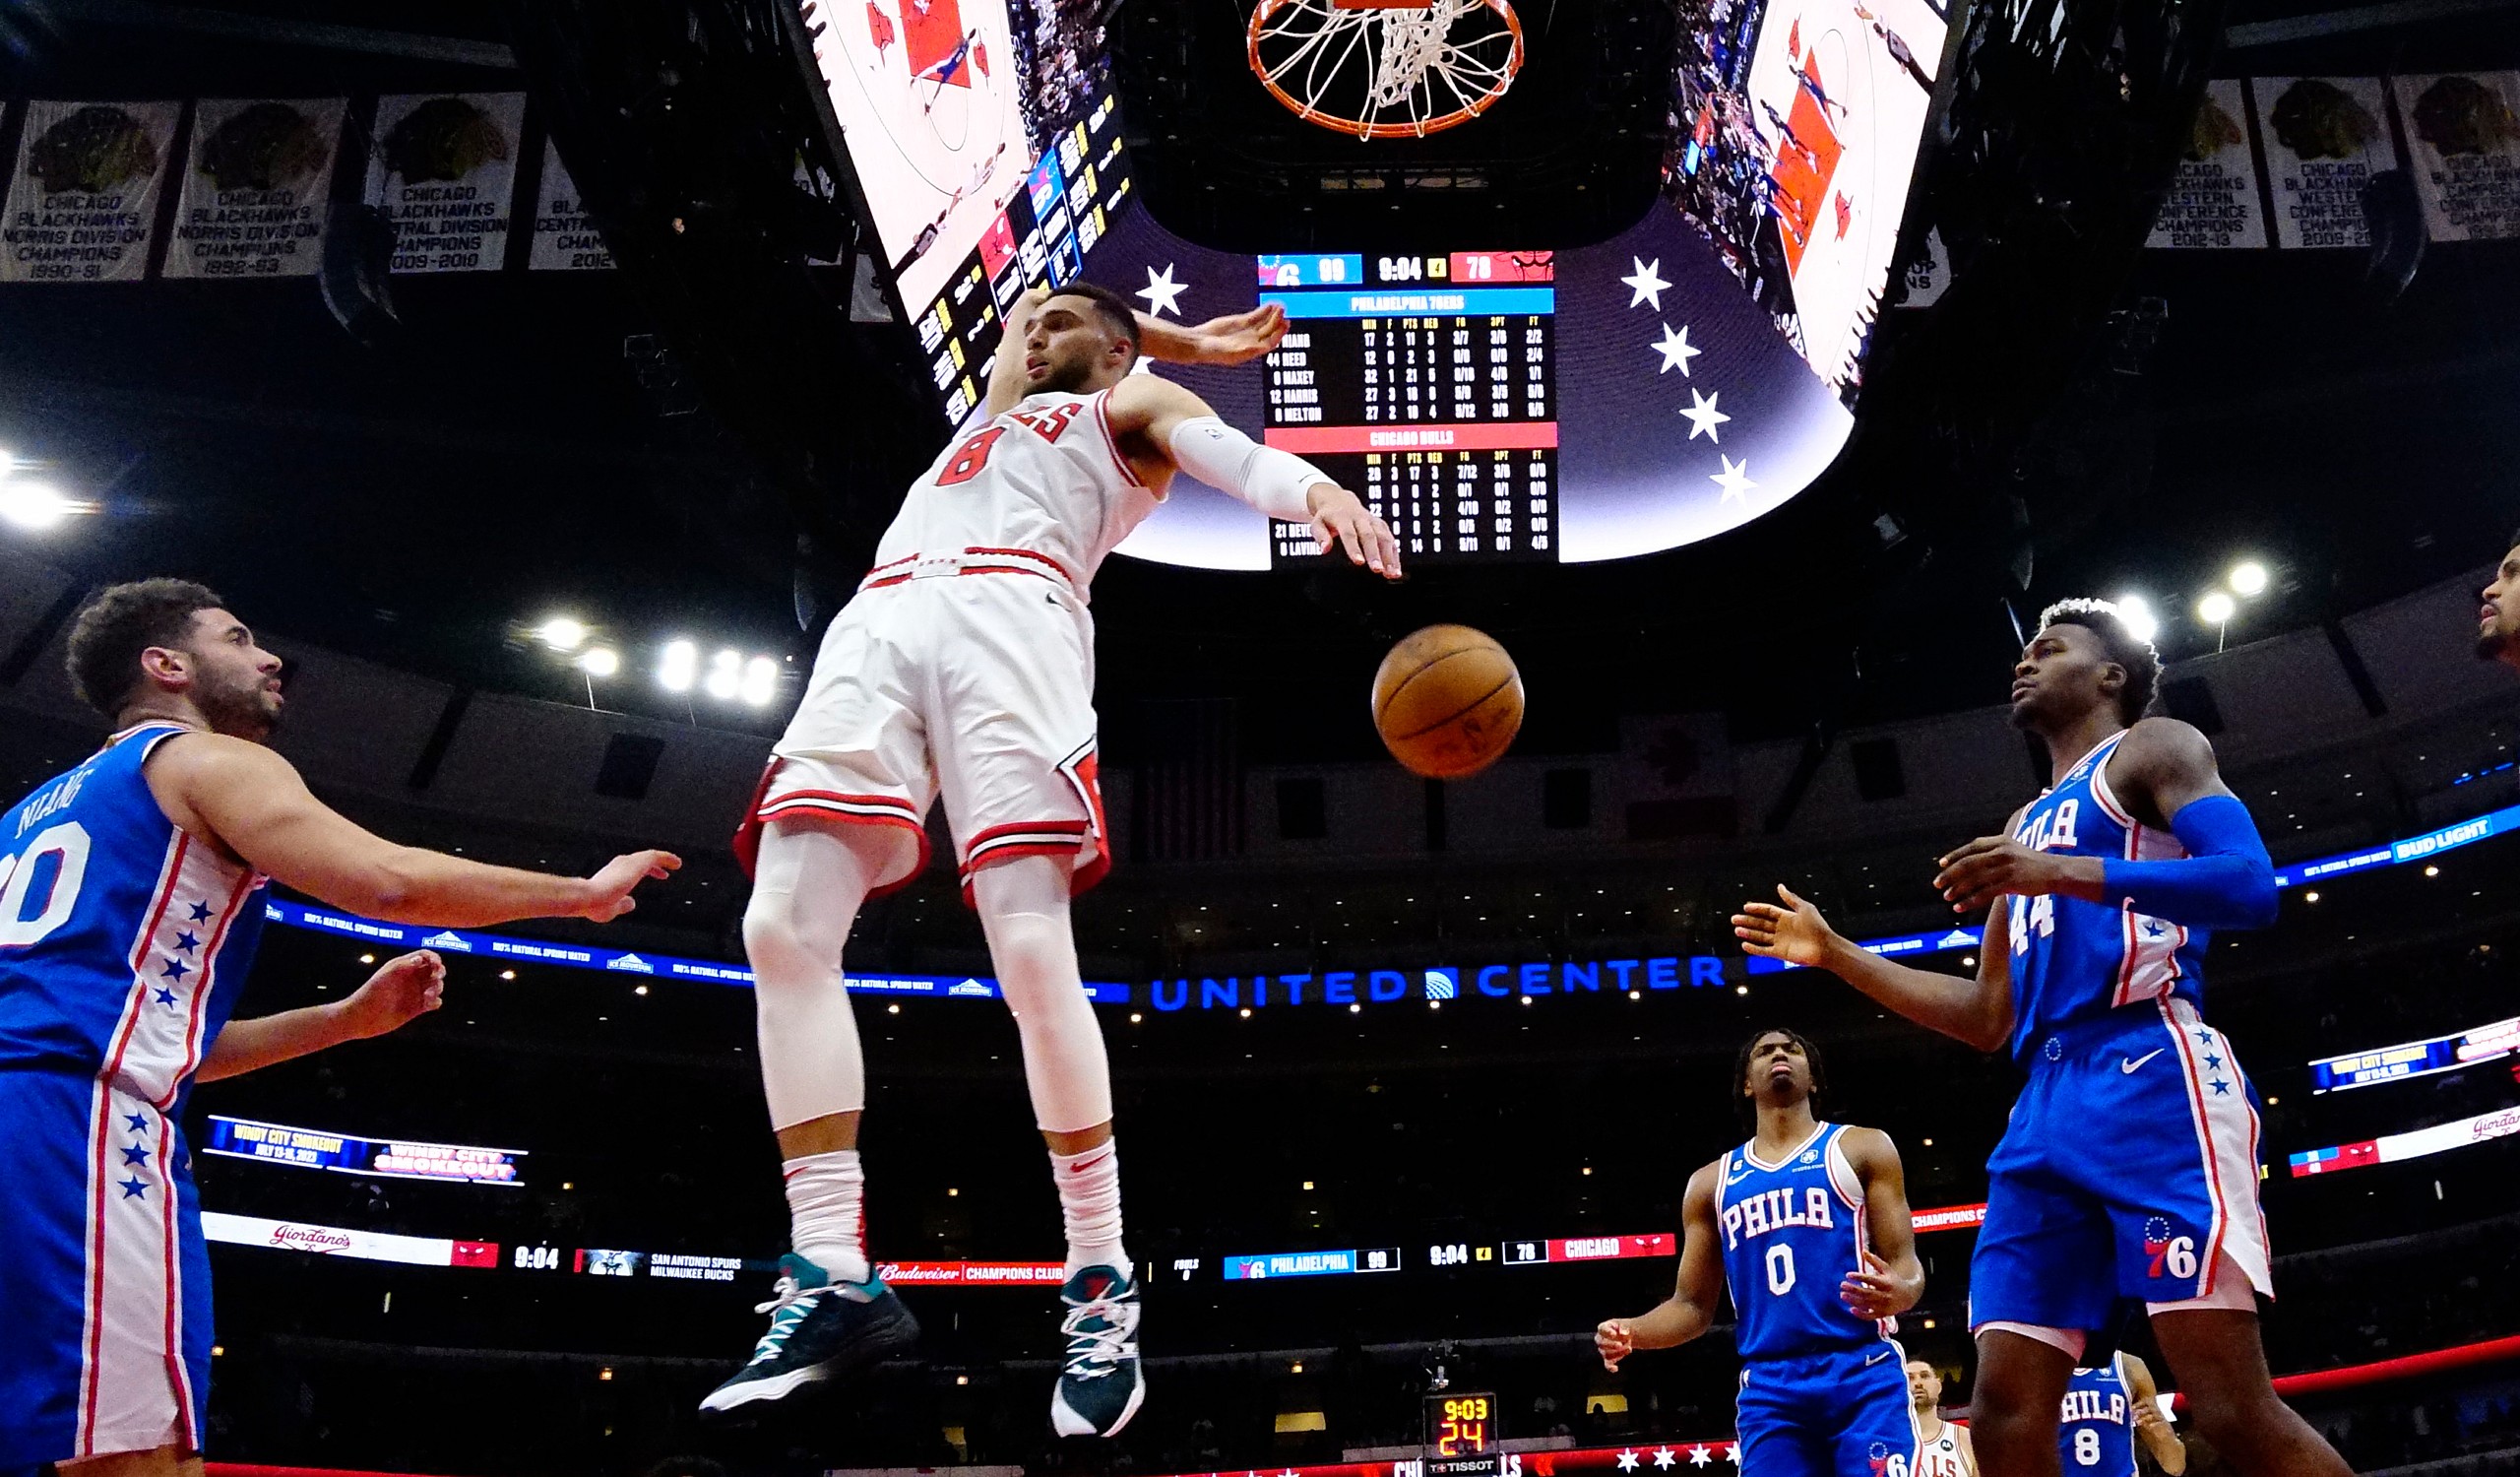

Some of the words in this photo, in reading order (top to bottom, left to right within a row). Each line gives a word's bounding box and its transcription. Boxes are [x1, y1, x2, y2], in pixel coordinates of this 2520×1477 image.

[2300, 163, 2366, 176] CHICAGO
[218, 191, 293, 207] CHICAGO
[403, 186, 476, 202] CHICAGO
[44, 196, 122, 211] CHICAGO
[18, 212, 141, 226] BLACKHAWKS
[191, 207, 311, 223] BLACKHAWKS
[72, 227, 147, 244] DIVISION
[439, 219, 507, 235] DIVISION
[18, 246, 122, 263] CHAMPIONS
[391, 253, 478, 269] 009-2010
[572, 253, 611, 268] 2012
[1320, 258, 1345, 283] 99
[1379, 257, 1421, 282] 9:04
[1433, 262, 1441, 275] 4
[1467, 256, 1491, 280] 78
[1352, 296, 1428, 312] PHILADELPHIA
[1364, 333, 1375, 347] 17
[1387, 332, 1394, 347] 2
[1406, 332, 1415, 346] 11
[1527, 329, 1543, 344] 2/2
[1267, 353, 1281, 367] 44
[1364, 351, 1376, 365] 12
[1408, 351, 1415, 364] 2
[1527, 348, 1543, 362] 2/4
[1283, 370, 1314, 385] MAXEY
[1406, 368, 1417, 383] 21
[1270, 390, 1283, 404] 12
[1365, 388, 1378, 402] 27
[1284, 407, 1322, 421] MELTON
[1366, 406, 1378, 419] 27
[1389, 406, 1396, 419] 2
[1429, 405, 1436, 418] 4
[1370, 431, 1418, 447] CHICAGO
[934, 425, 1007, 487] 8
[1410, 466, 1419, 480] 17
[1457, 465, 1478, 480] 7/12
[1432, 483, 1439, 497] 2
[1275, 524, 1287, 539] 21
[1433, 520, 1440, 534] 2
[1412, 539, 1422, 552] 14
[15, 769, 94, 840] NIANG
[2396, 836, 2435, 860] BUD
[2435, 819, 2488, 849] LIGHT
[304, 912, 322, 926] 100%
[323, 917, 353, 931] NATURAL
[379, 928, 404, 940] WATER
[2007, 893, 2055, 955] 44
[492, 941, 510, 953] 100%
[511, 944, 542, 957] NATURAL
[568, 951, 591, 963] WATER
[673, 964, 690, 975] 100%
[690, 966, 719, 978] NATURAL
[743, 971, 757, 982] WAT
[860, 979, 889, 990] NATURAL
[912, 981, 934, 991] WATER
[1152, 970, 1408, 1012] UNITED
[1477, 955, 1726, 999] CENTER
[234, 1124, 267, 1142] WINDY
[268, 1129, 290, 1145] CITY
[291, 1133, 344, 1154] SMOKEOUT
[255, 1143, 274, 1156] JULY
[296, 1150, 317, 1163] 2023
[389, 1144, 456, 1160] WINDY
[456, 1149, 502, 1164] CITY
[374, 1154, 515, 1180] SMOKEOUT
[1722, 1187, 1834, 1252] PHILA
[1912, 1209, 1976, 1228] CHAMPIONS
[269, 1225, 351, 1249] Giordano's
[515, 1245, 559, 1270] 9:04
[651, 1252, 670, 1266] SAN
[670, 1254, 711, 1268] ANTONIO
[711, 1256, 742, 1270] SPURS
[1271, 1253, 1350, 1274] PHILADELPHIA
[1367, 1252, 1387, 1269] 99
[1429, 1244, 1468, 1266] 9:04
[1516, 1243, 1536, 1261] 78
[1564, 1237, 1619, 1258] CHICAGO
[2144, 1236, 2197, 1279] 76
[650, 1265, 703, 1280] MILWAUKEE
[704, 1268, 734, 1282] BUCKS
[876, 1263, 960, 1281] Budweiser
[966, 1266, 1034, 1281] CHAMPIONS
[1035, 1265, 1064, 1280] CLUB
[1765, 1243, 1796, 1297] 0
[1444, 1399, 1487, 1421] 9:03
[2061, 1390, 2125, 1425] HILA
[1439, 1421, 1485, 1456] 24
[2074, 1429, 2101, 1466] 8
[1447, 1460, 1494, 1472] TISSOT
